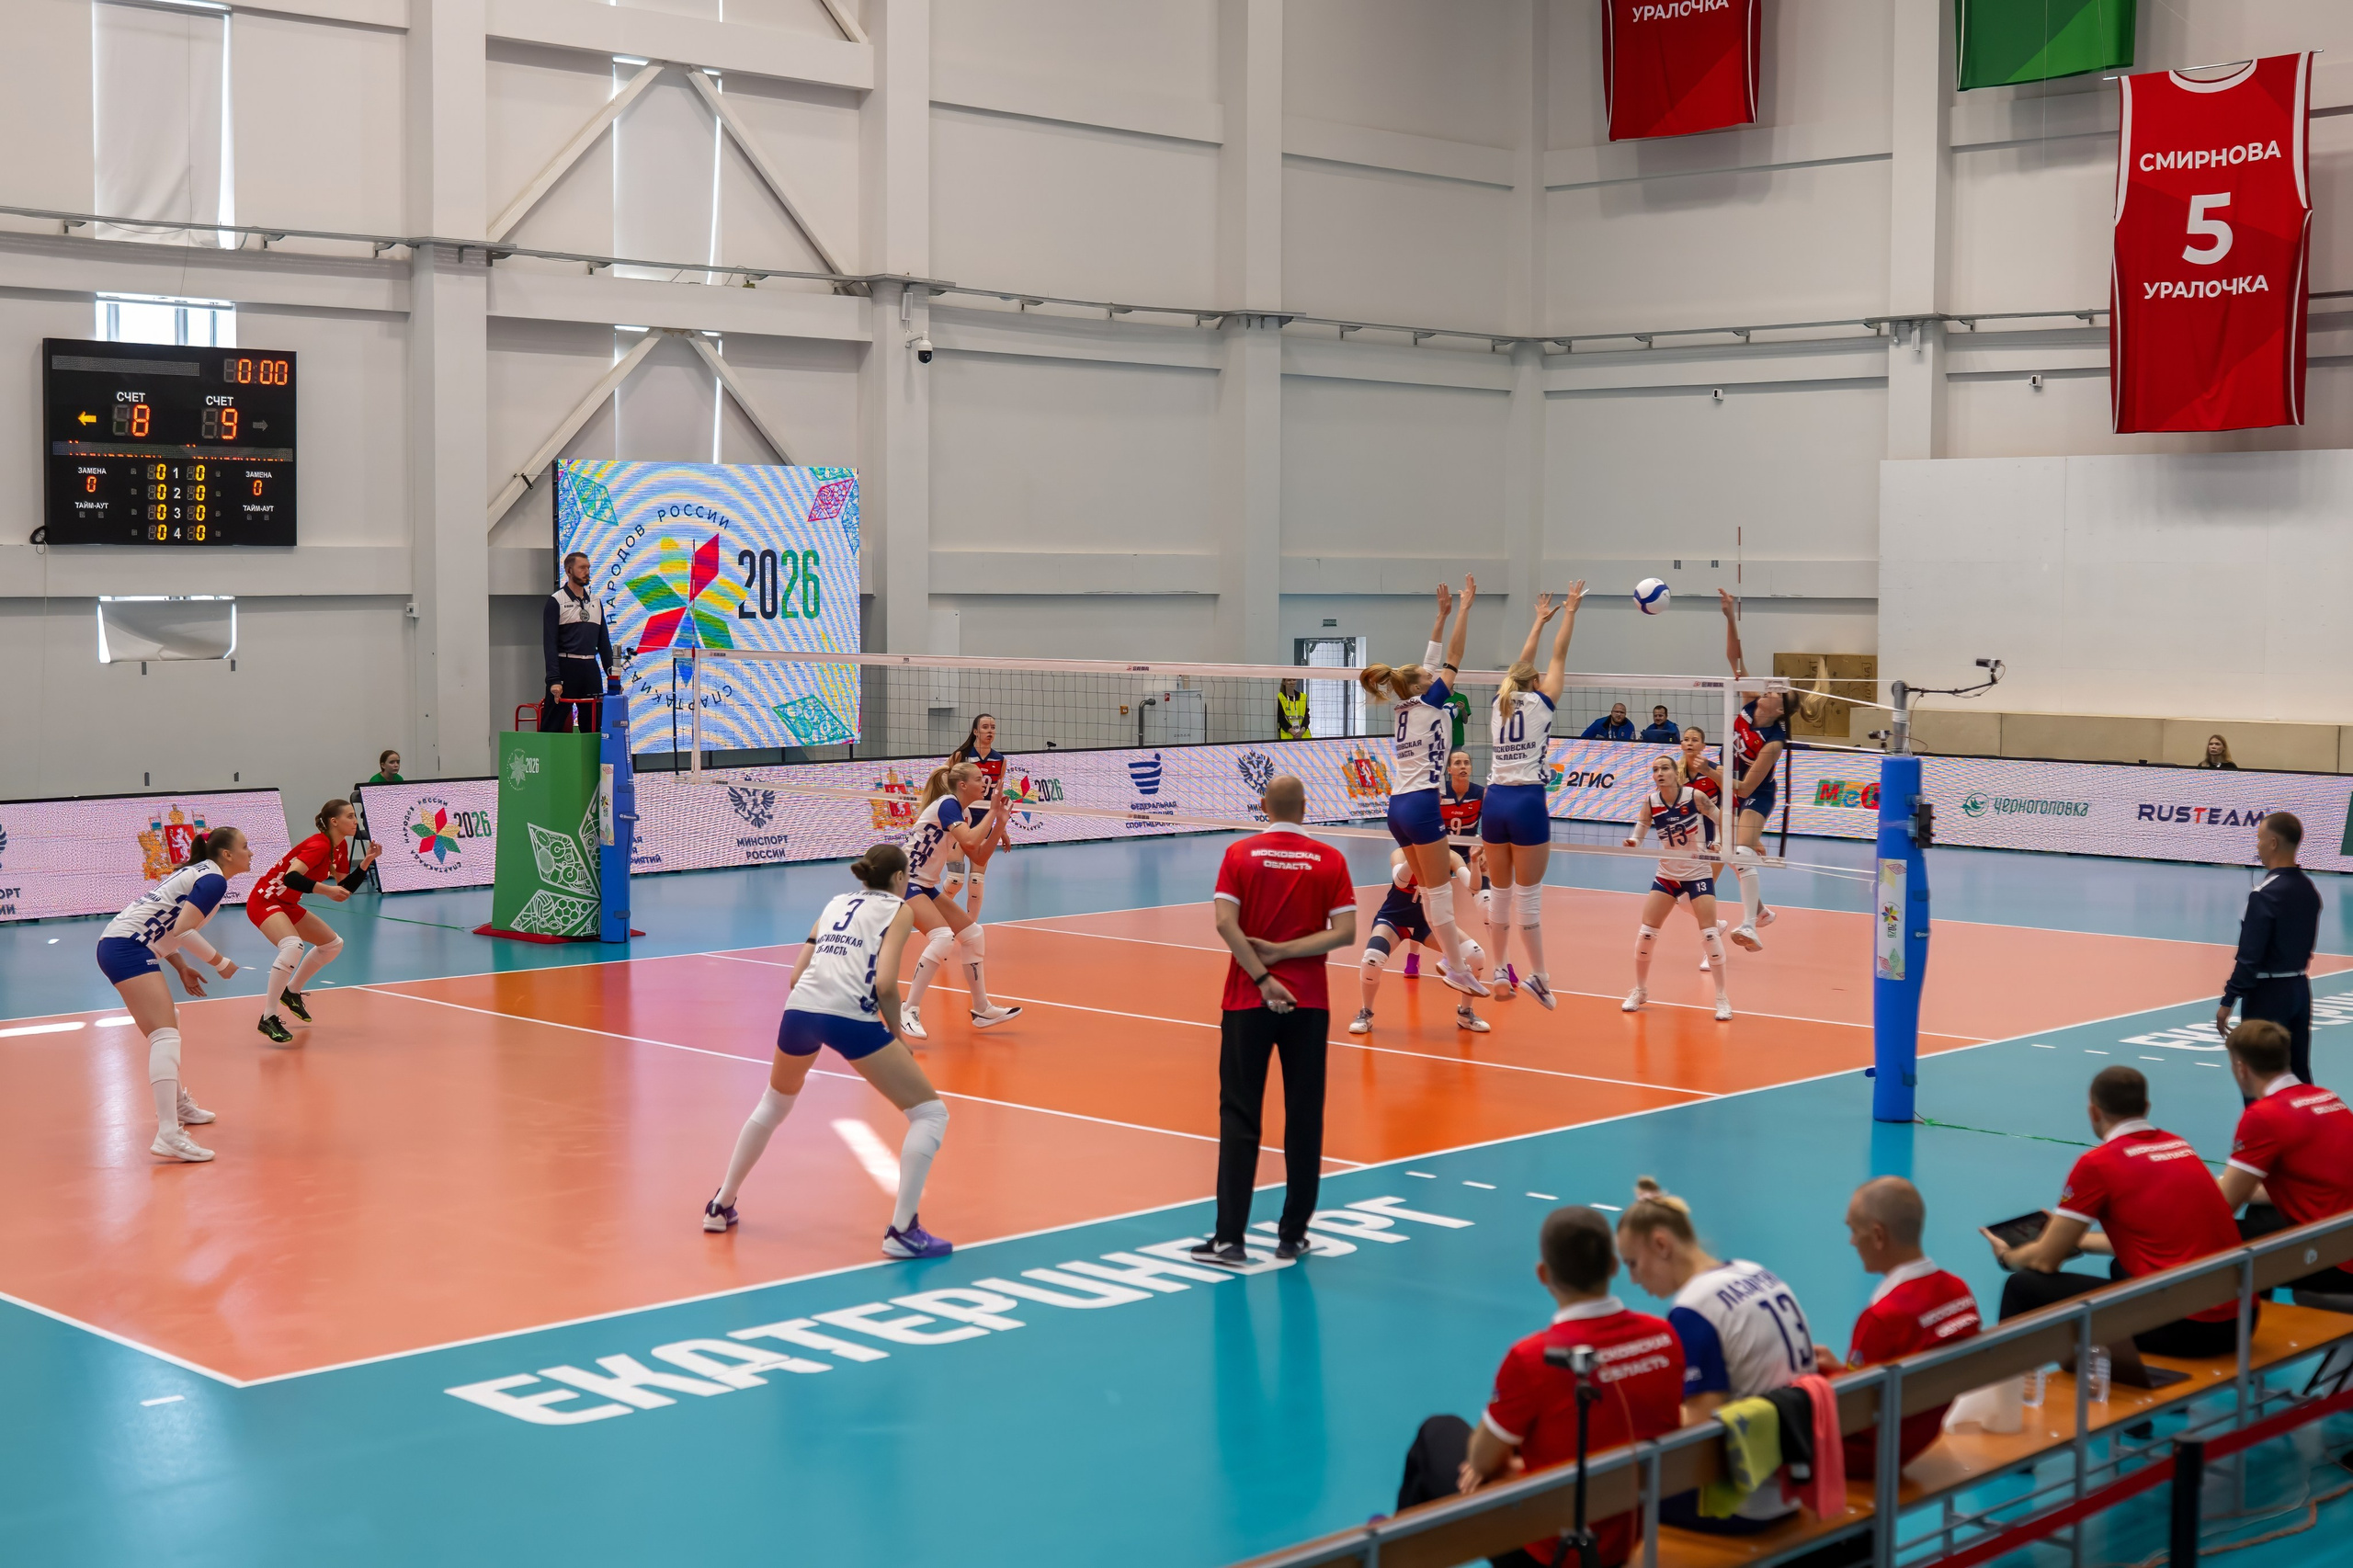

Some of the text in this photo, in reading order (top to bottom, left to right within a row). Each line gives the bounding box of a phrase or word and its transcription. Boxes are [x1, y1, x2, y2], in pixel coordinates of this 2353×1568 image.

[1632, 0, 1730, 23] УРАЛОЧКА
[2139, 140, 2281, 173] СМИРНОВА
[2181, 190, 2234, 266] 5
[2143, 274, 2269, 301] УРАЛОЧКА
[116, 392, 146, 403] СЧЕТ
[205, 395, 234, 406] СЧЕТ
[131, 404, 151, 437] 8
[221, 407, 238, 440] 9
[77, 466, 108, 475] ЗАМЕНА
[156, 463, 206, 482] 0 1 0
[245, 471, 273, 479] ЗАМЕНА
[86, 475, 97, 493] 0
[156, 483, 206, 501] 0 2 0
[253, 480, 263, 496] 0
[74, 501, 109, 509] ТАЙМ-АУТ
[156, 504, 206, 521] 0 3 0
[243, 504, 274, 512] ТАЙМ-АУТ
[156, 524, 206, 541] 0 4 0
[606, 503, 730, 625] НАРОДОВ РОССИИ
[737, 548, 821, 620] 2026
[621, 655, 733, 710] СПАРТАКИАД
[1397, 710, 1409, 743] 8
[525, 757, 540, 774] 2026
[1567, 771, 1615, 789] 2ГИС
[1034, 778, 1064, 802] 2026
[2138, 803, 2266, 827] RUSTEAM
[453, 810, 493, 839] 2026
[736, 835, 789, 847] МИНСПОРТ
[1665, 823, 1688, 847] 13
[745, 848, 786, 860] РОССИИ
[1250, 849, 1322, 862] МОСКОВСКАЯ
[1263, 859, 1313, 870] ОБЛАСТЬ
[1696, 881, 1708, 892] 13
[833, 898, 865, 931] 3
[1757, 1292, 1815, 1373] 13
